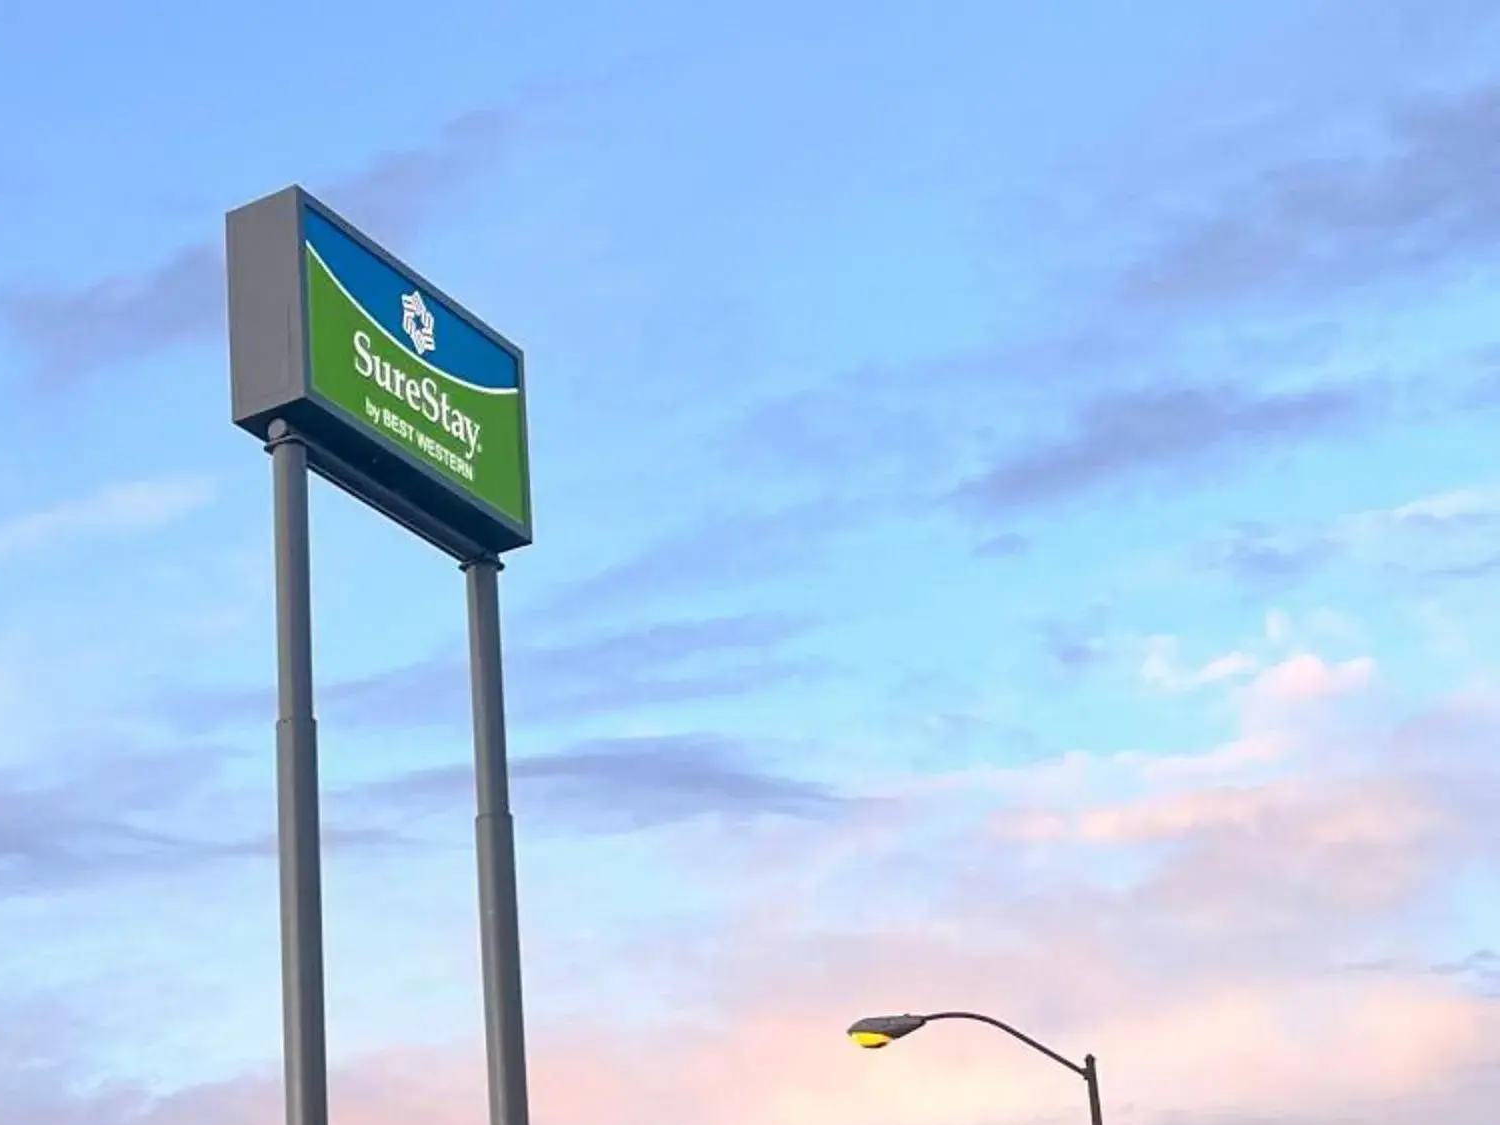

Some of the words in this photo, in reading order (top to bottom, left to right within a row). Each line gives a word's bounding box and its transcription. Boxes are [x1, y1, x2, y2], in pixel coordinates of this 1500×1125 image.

[353, 331, 481, 460] SureStay
[365, 396, 380, 424] by
[383, 408, 414, 441] BEST
[416, 430, 474, 480] WESTERN
